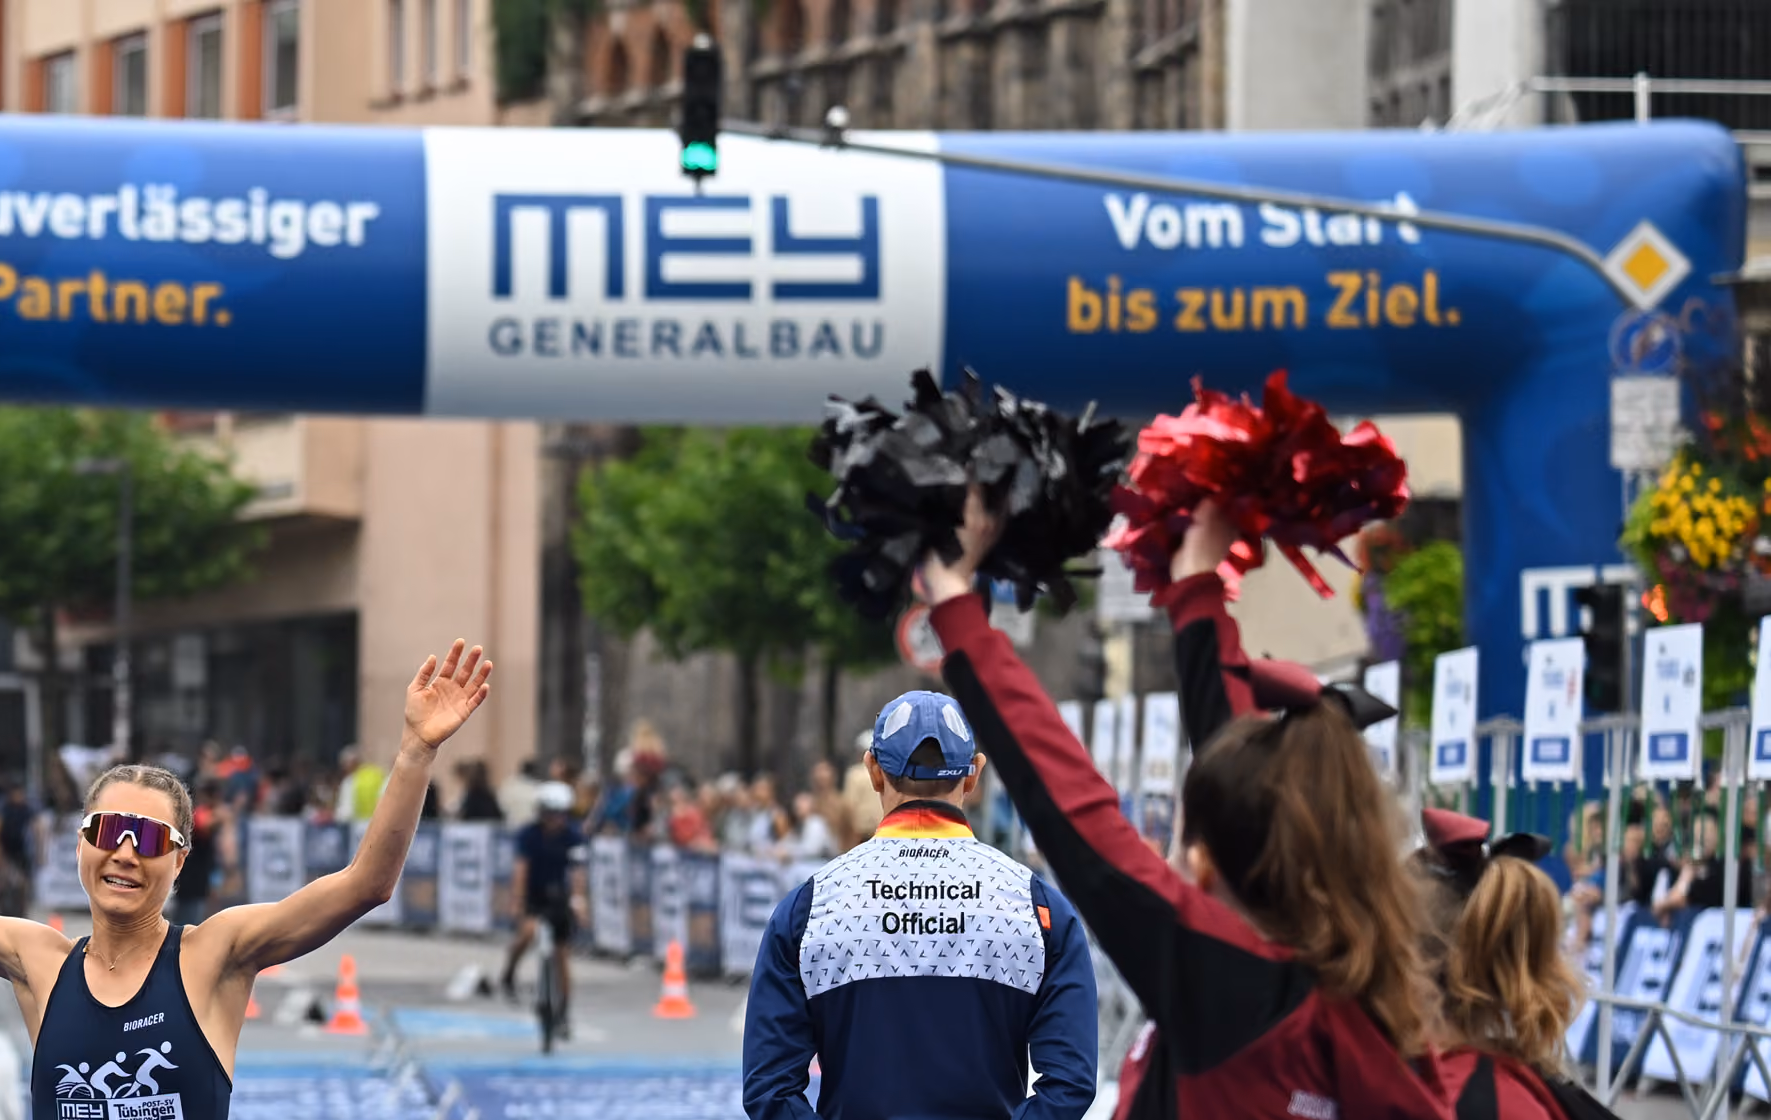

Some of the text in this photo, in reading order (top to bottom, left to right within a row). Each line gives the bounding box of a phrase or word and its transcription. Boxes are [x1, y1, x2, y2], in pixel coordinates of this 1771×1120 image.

[1104, 191, 1421, 249] Vom Start
[493, 193, 880, 301] MEY
[1067, 270, 1460, 332] bis zum Ziel.
[489, 317, 883, 359] GENERALBAU
[898, 848, 949, 859] BIORACER
[866, 880, 980, 900] Technical
[881, 911, 966, 935] Official
[123, 1012, 165, 1031] BIORACER
[61, 1103, 104, 1119] MEY
